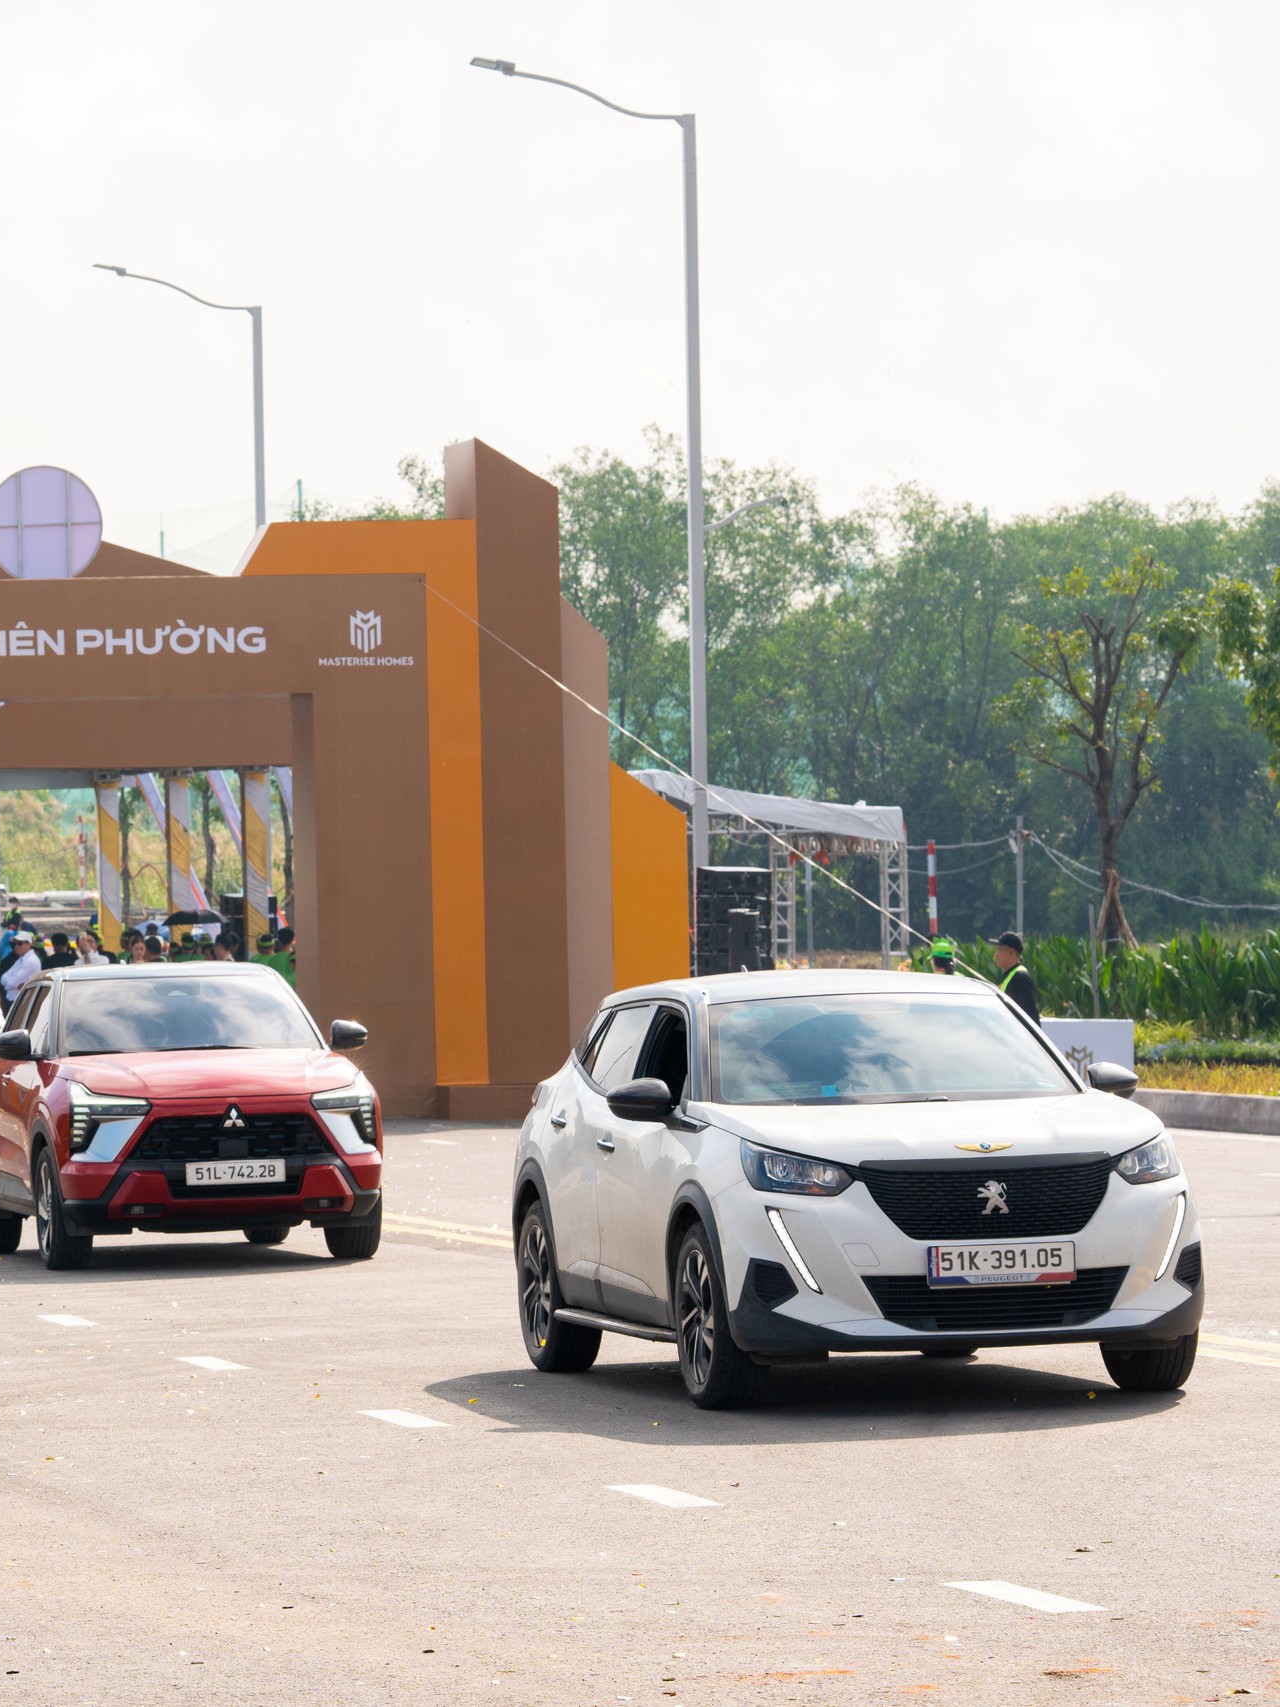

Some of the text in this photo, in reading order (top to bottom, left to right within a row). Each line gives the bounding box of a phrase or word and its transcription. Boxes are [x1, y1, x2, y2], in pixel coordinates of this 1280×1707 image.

[76, 619, 267, 655] PHƯỜNG
[318, 656, 414, 666] MASTERISE HOMES
[195, 1165, 276, 1180] 51L-742.28
[941, 1248, 1062, 1271] 51K-391.05
